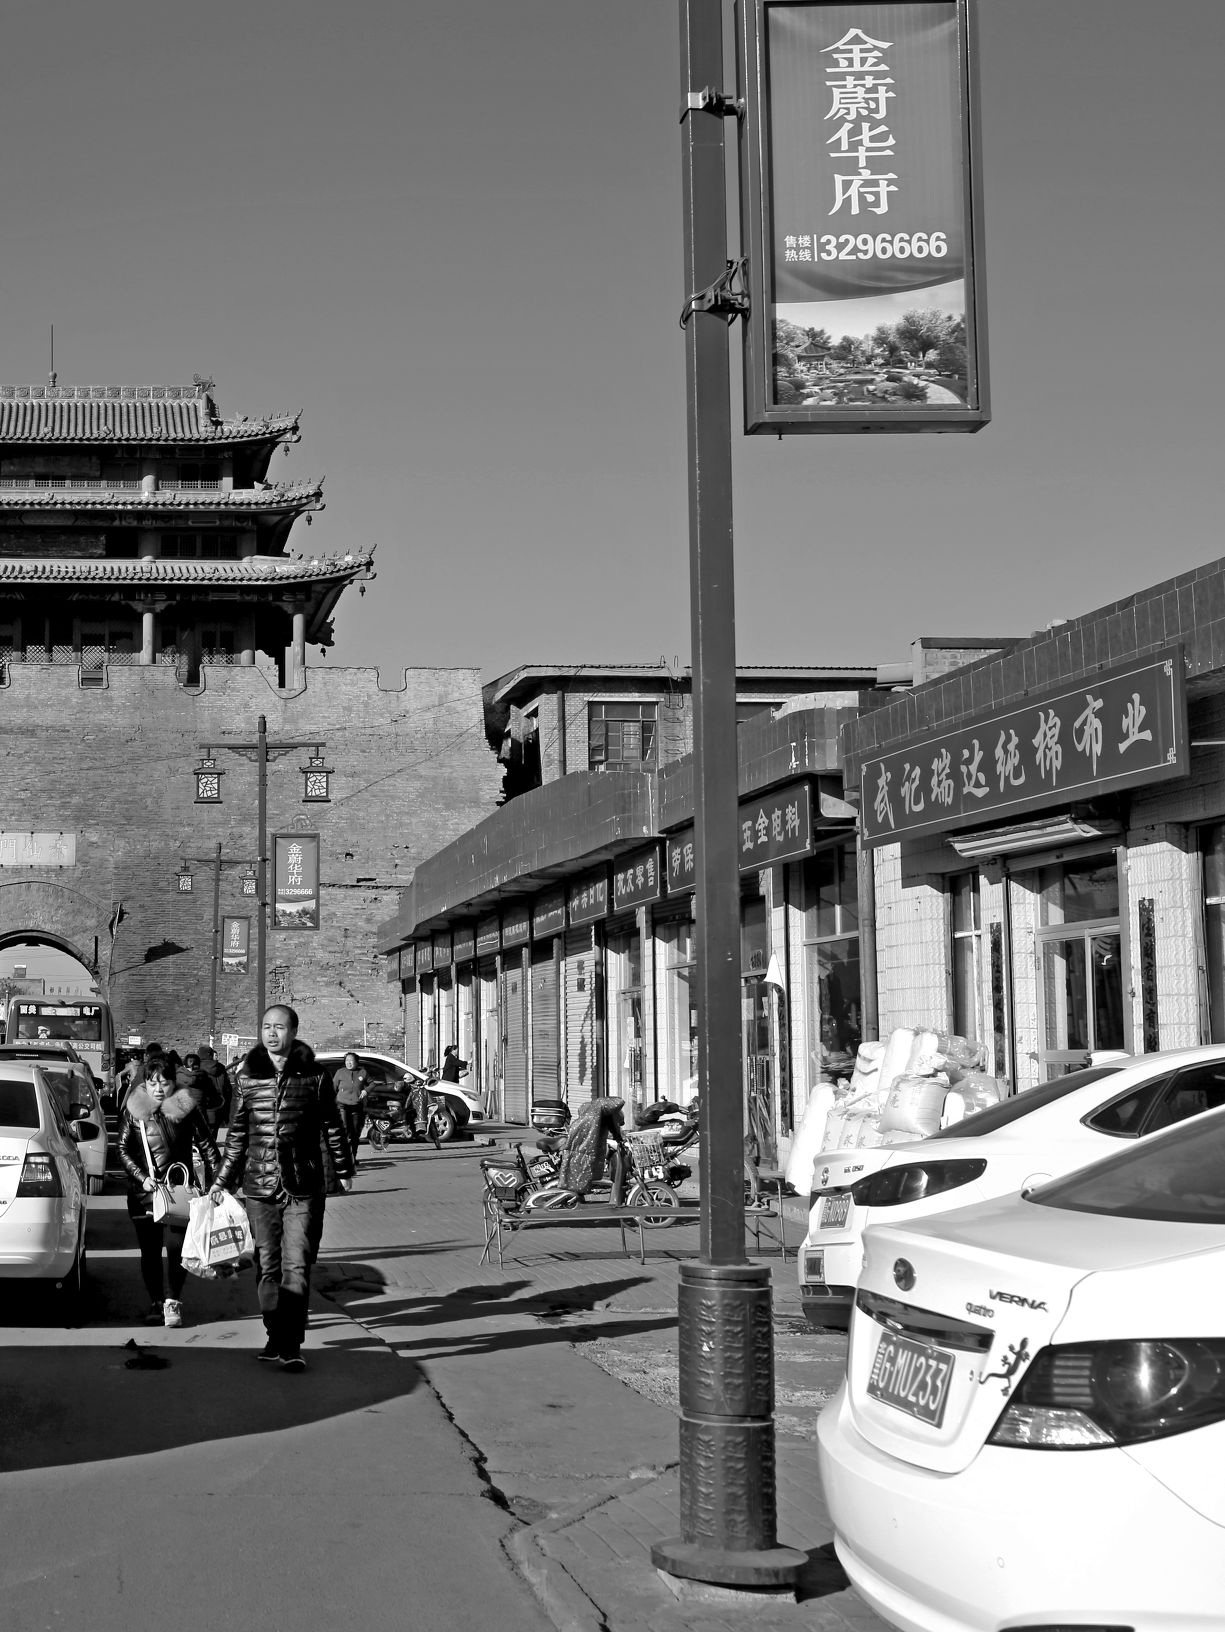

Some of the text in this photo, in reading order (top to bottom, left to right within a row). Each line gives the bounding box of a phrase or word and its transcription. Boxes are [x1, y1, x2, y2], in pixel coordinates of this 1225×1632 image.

[819, 27, 899, 216] 金蔚华府
[784, 235, 812, 248] 售楼
[784, 249, 812, 262] 热线
[820, 232, 948, 261] 3296666
[873, 692, 1153, 830] 武记瑞达纯棉布业
[741, 800, 801, 853] 五金电料
[286, 842, 304, 886] 金蔚华府
[82, 1006, 99, 1016] 电厂
[989, 1289, 1049, 1313] VERNA
